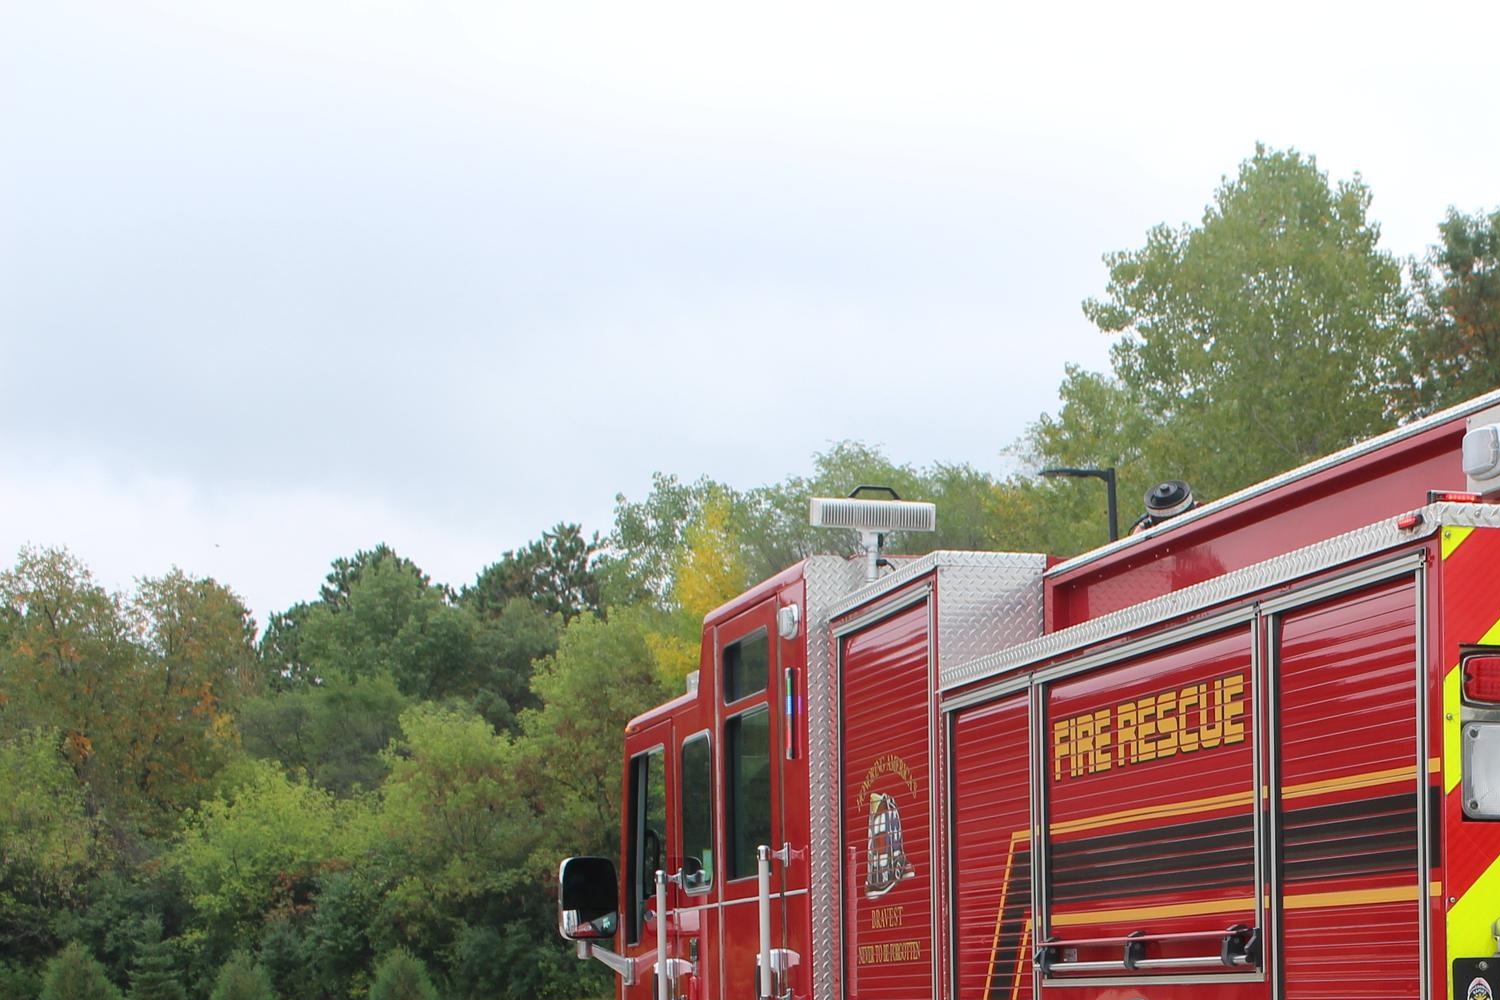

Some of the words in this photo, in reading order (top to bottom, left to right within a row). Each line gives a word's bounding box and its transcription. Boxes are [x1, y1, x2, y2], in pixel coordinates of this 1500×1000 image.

[1054, 708, 1112, 782] FIRE
[1117, 673, 1245, 767] RESCUE
[871, 906, 904, 929] BRAVEST
[858, 945, 874, 964] NEVER
[875, 944, 883, 963] TO
[890, 940, 921, 962] FORGOTTEN
